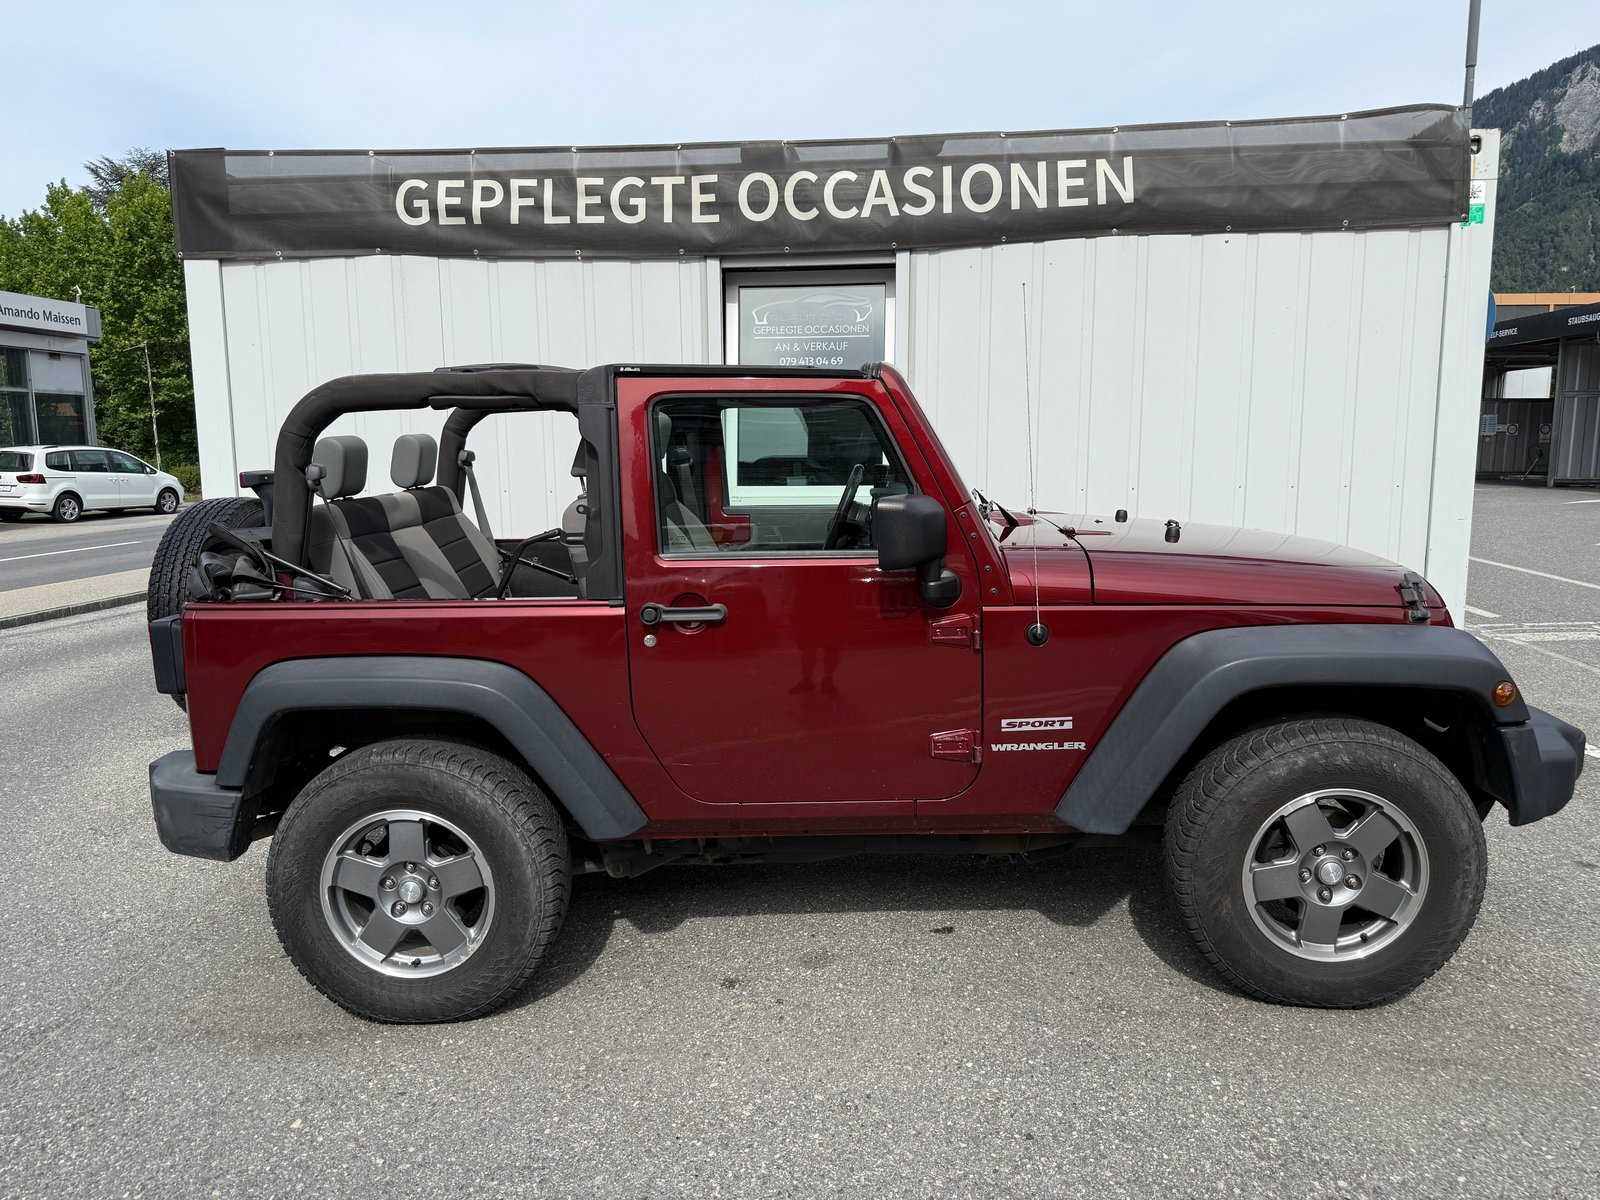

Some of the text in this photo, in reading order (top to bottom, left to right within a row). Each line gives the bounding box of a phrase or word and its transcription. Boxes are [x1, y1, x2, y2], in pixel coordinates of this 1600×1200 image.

[395, 155, 1134, 226] GEPFLEGTE OCCASIONEN
[43, 309, 81, 326] Maissen
[753, 324, 870, 335] GEPFLEGTE OCCASIONEN
[1490, 327, 1518, 339] ELF-SERVICE
[775, 341, 849, 352] AN & VERKAUF
[779, 356, 844, 366] 079 413 04 69
[1003, 718, 1070, 730] SPORT
[990, 741, 1087, 752] WRANGLER
